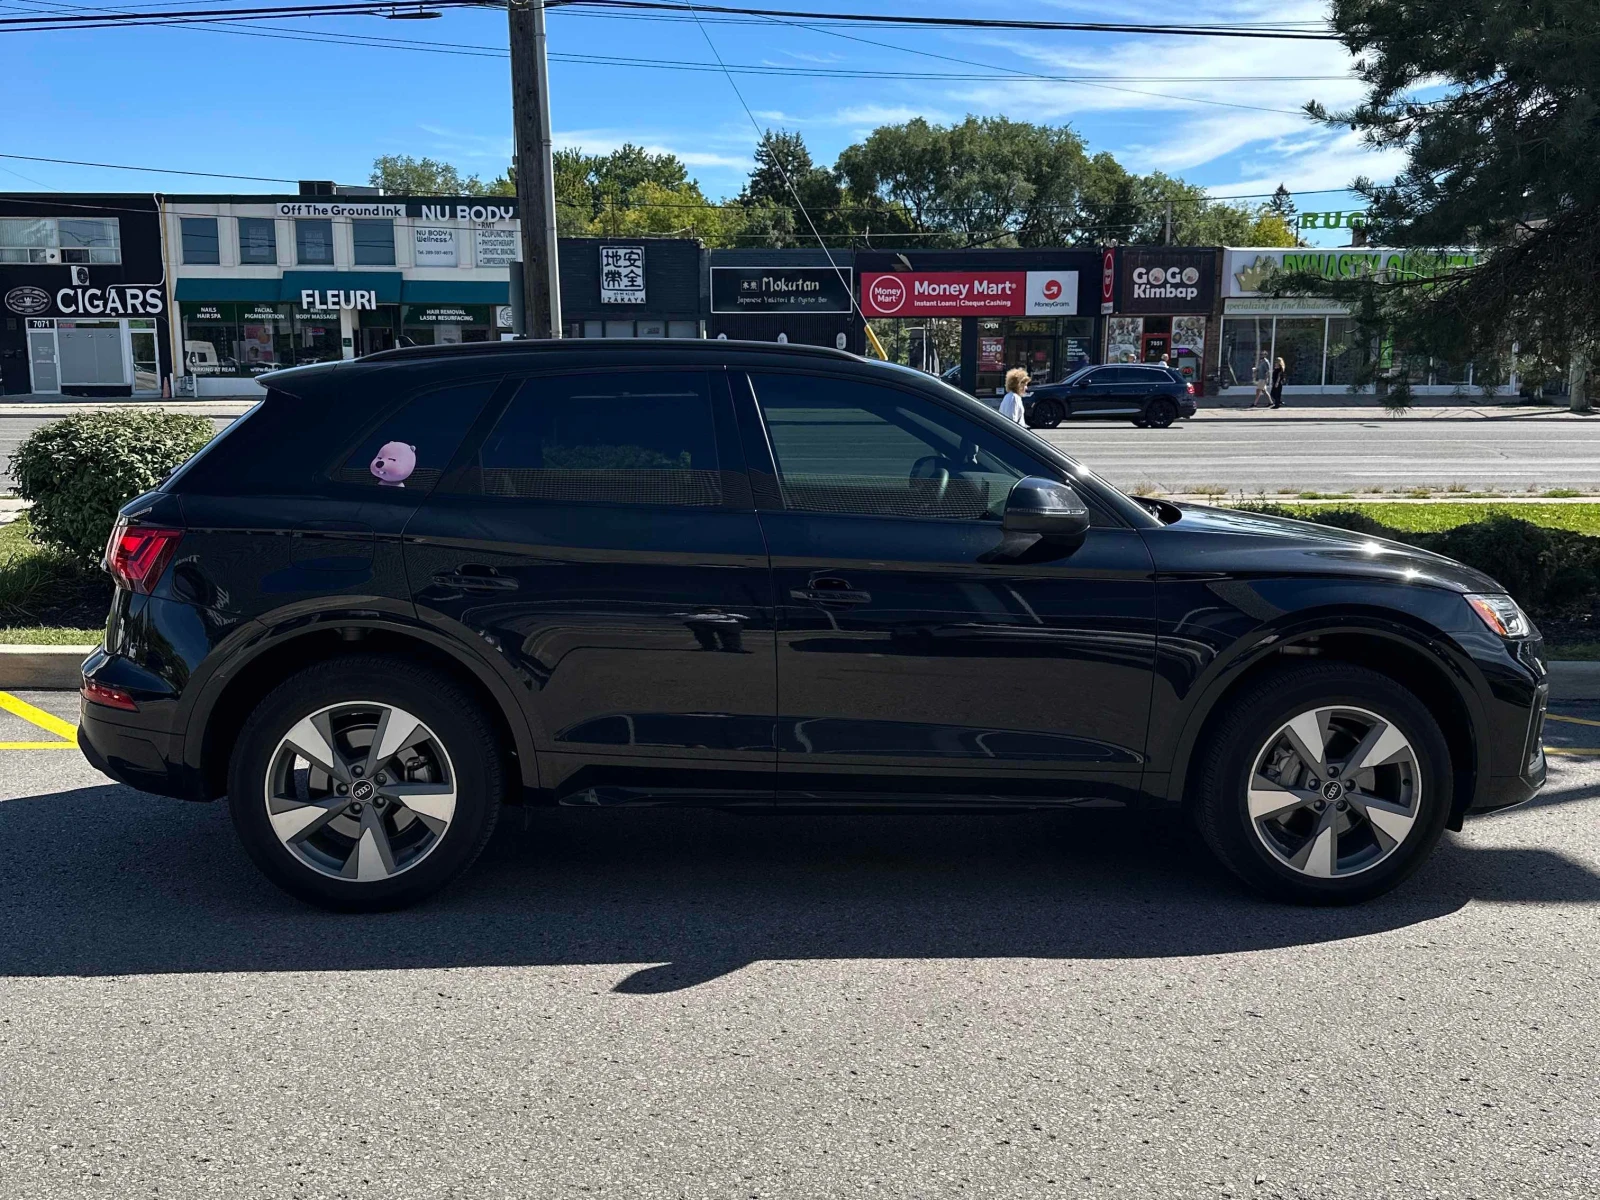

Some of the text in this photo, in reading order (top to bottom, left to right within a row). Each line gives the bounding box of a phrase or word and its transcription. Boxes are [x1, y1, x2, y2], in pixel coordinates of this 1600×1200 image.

[280, 204, 402, 217] Off The Ground Ink
[421, 204, 514, 223] NU BODY
[428, 229, 448, 237] BODY
[481, 230, 514, 238] ACUPUNCTURE
[416, 235, 448, 243] Wellness
[762, 276, 820, 292] Mokutan
[914, 280, 970, 298] Money
[874, 287, 901, 297] Money
[1133, 284, 1198, 301] Kimbap
[56, 287, 164, 314] CIGARS
[301, 289, 377, 310] FLEURI
[914, 299, 1011, 308] Instant Loans Cheque Cashing
[1034, 301, 1070, 309] MoneyGram
[33, 320, 50, 328] 7071
